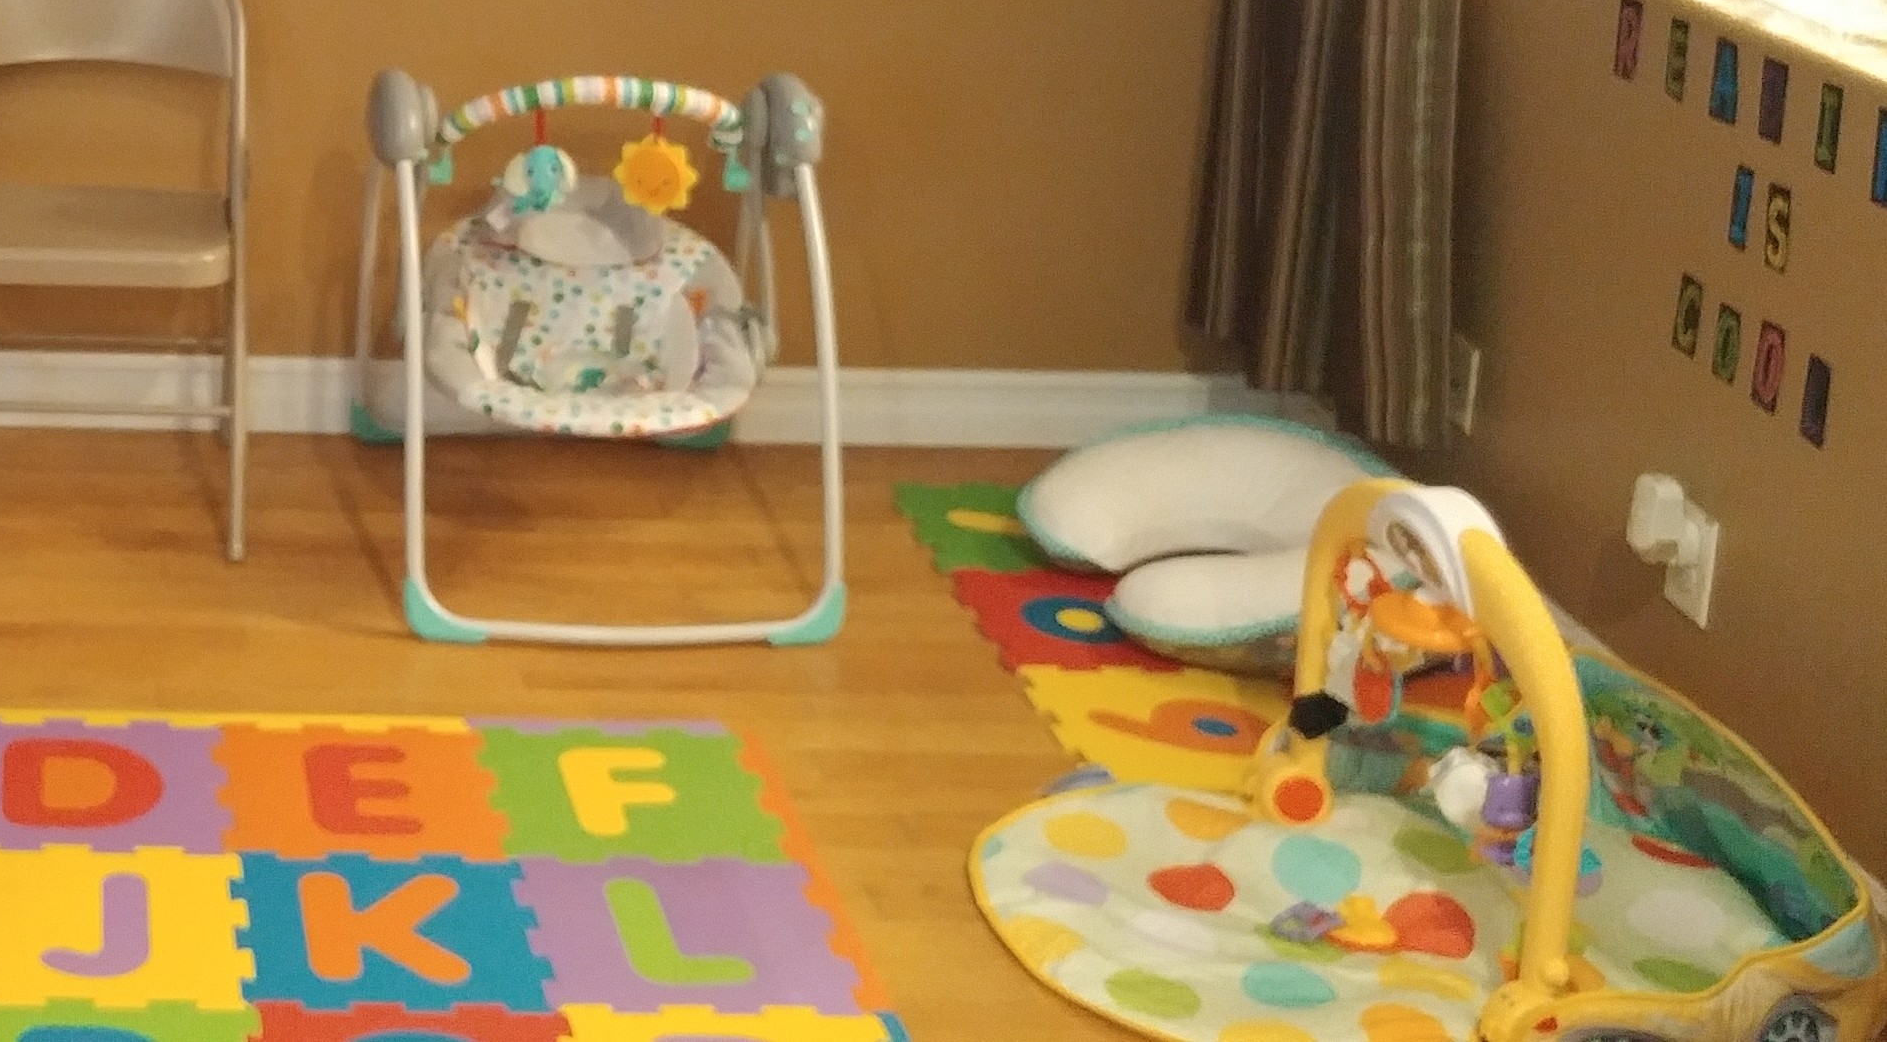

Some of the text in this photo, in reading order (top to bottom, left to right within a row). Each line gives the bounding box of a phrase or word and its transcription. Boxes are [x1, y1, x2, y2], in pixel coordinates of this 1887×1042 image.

[1, 739, 164, 828] D
[302, 744, 424, 835] E
[557, 746, 676, 837] F
[40, 872, 151, 979] J
[297, 872, 472, 984] K
[603, 879, 756, 986] L
